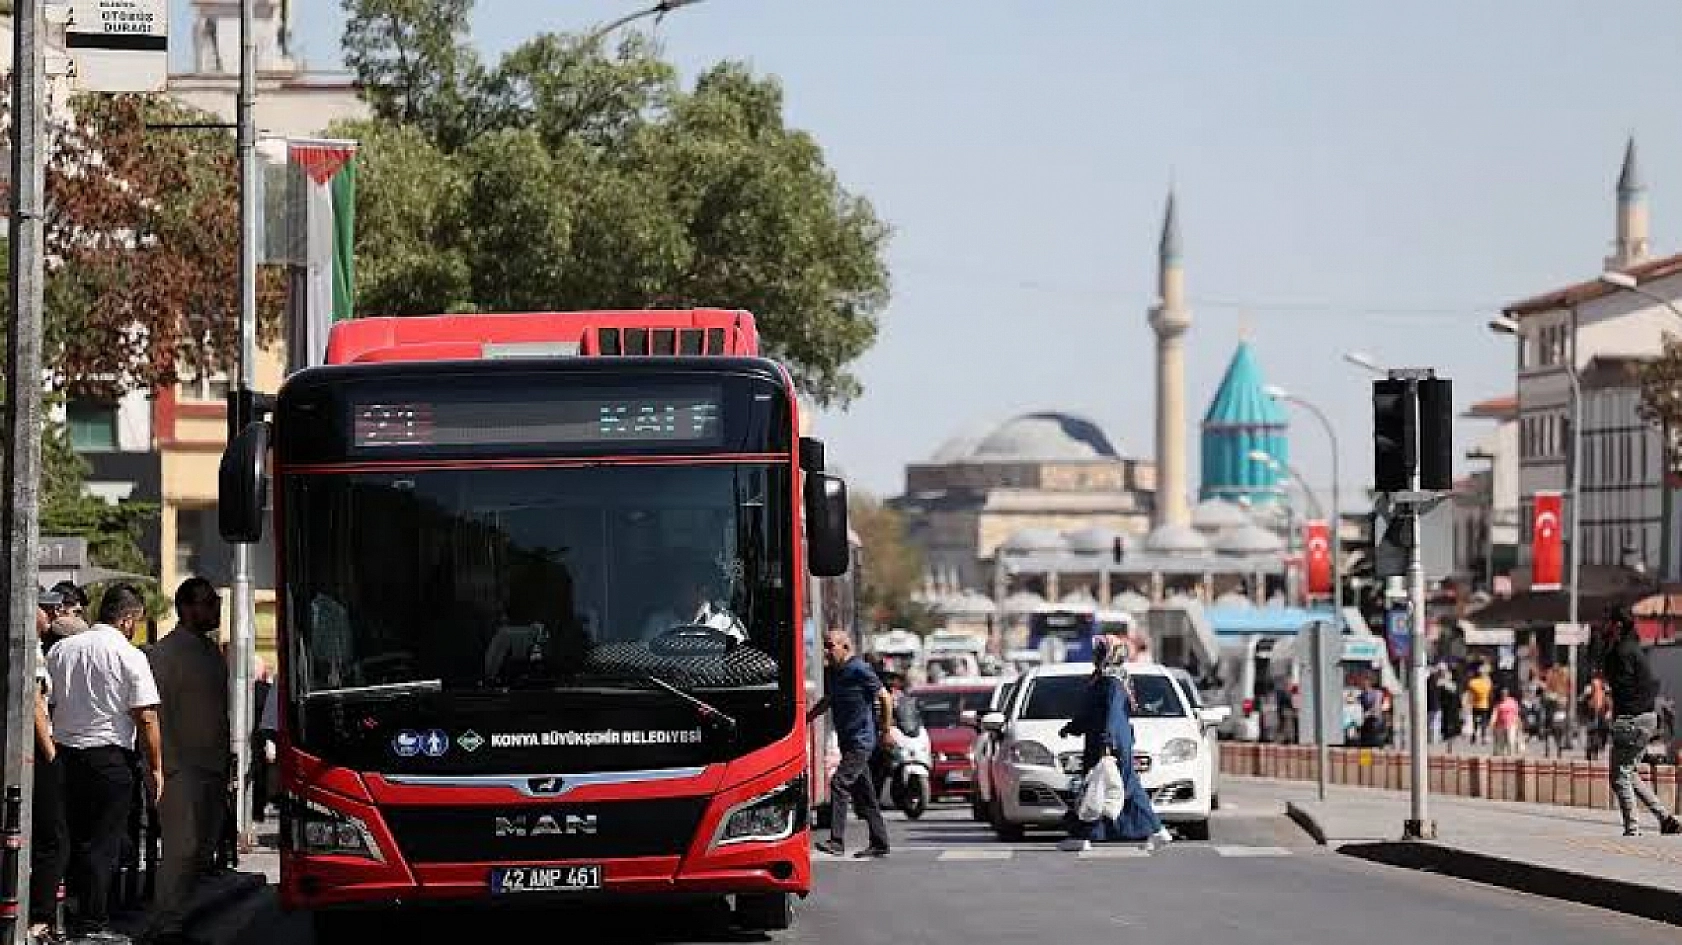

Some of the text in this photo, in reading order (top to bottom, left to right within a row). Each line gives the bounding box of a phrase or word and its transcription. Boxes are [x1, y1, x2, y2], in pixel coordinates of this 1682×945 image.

[492, 732, 540, 747] KONYA
[496, 815, 597, 836] MAN
[503, 868, 524, 887] 42
[566, 867, 598, 886] 461
